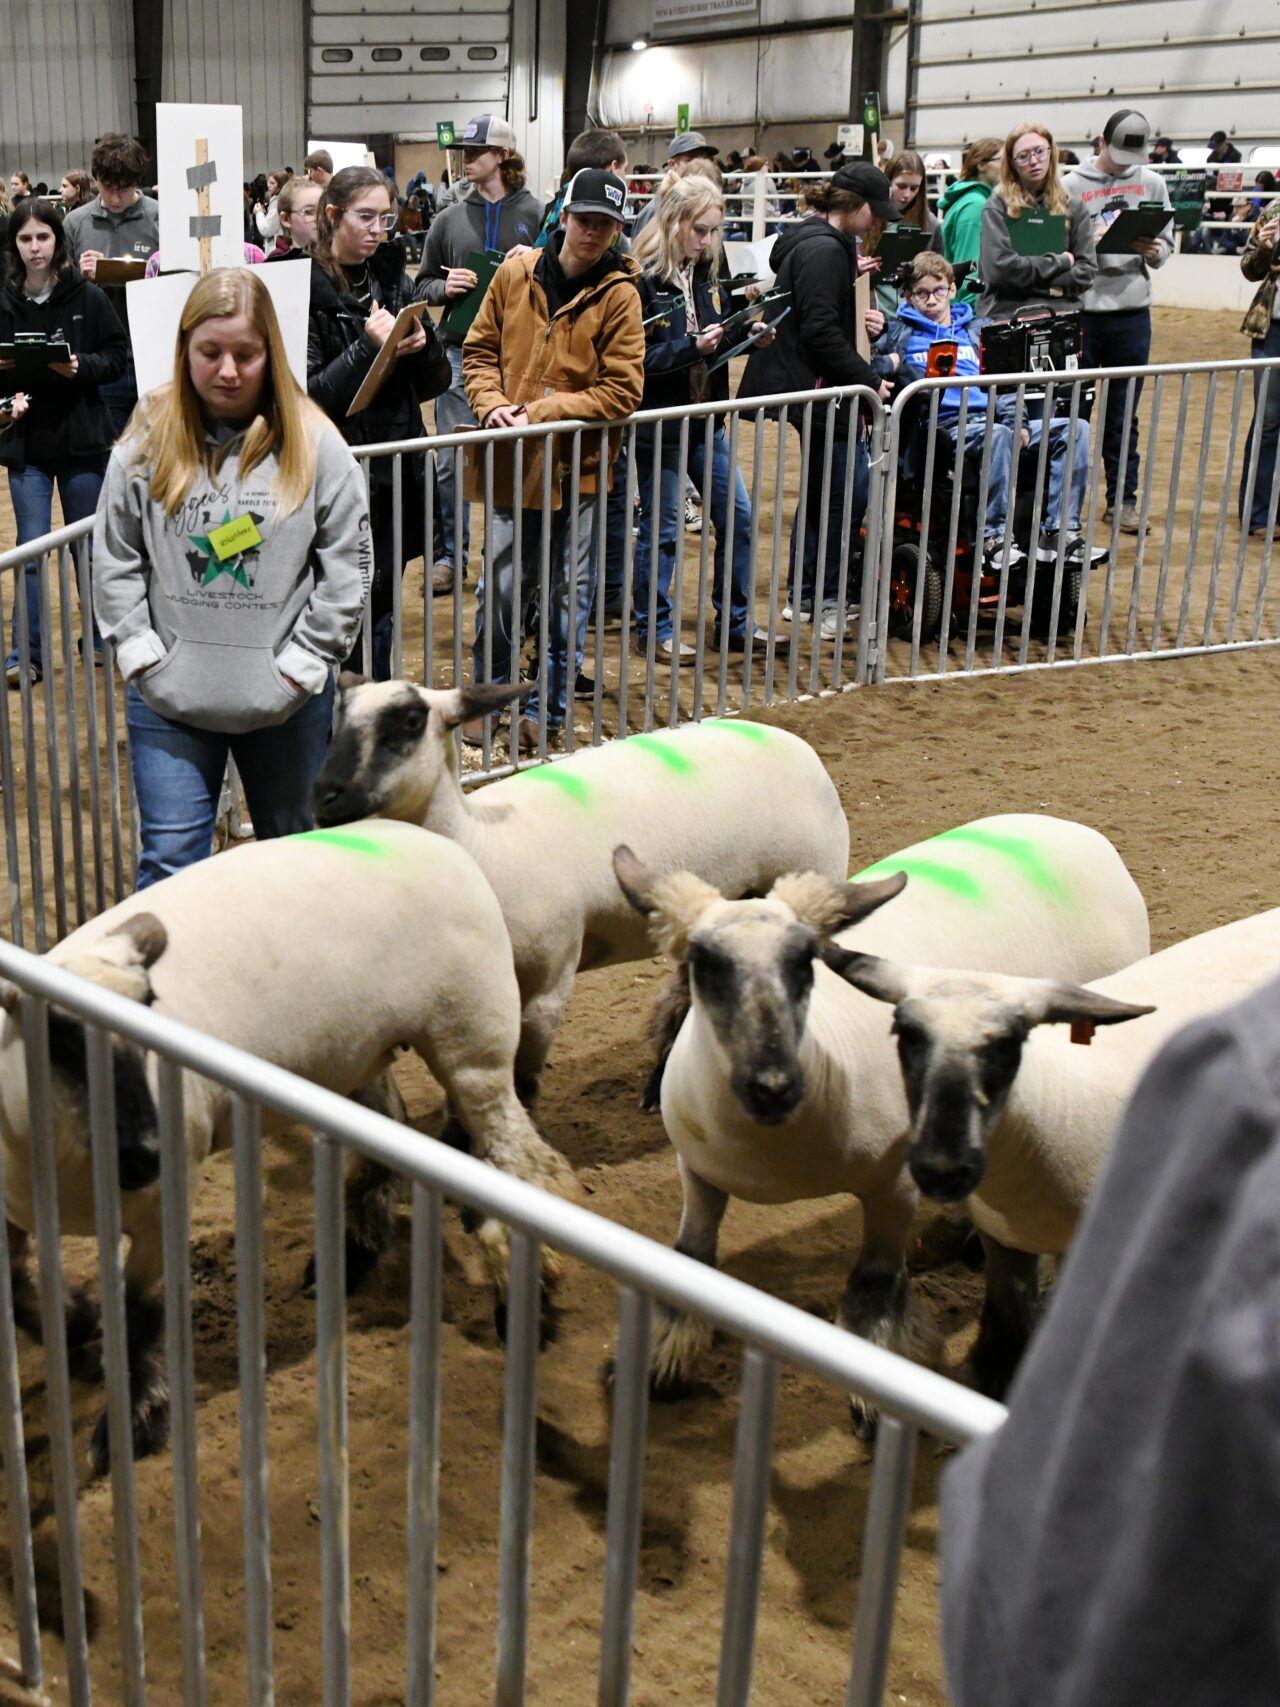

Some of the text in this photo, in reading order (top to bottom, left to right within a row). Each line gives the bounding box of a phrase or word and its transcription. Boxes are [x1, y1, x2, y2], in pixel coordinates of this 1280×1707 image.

[443, 133, 450, 142] D
[164, 483, 232, 538] ggies
[186, 590, 263, 600] LIVESTOCK
